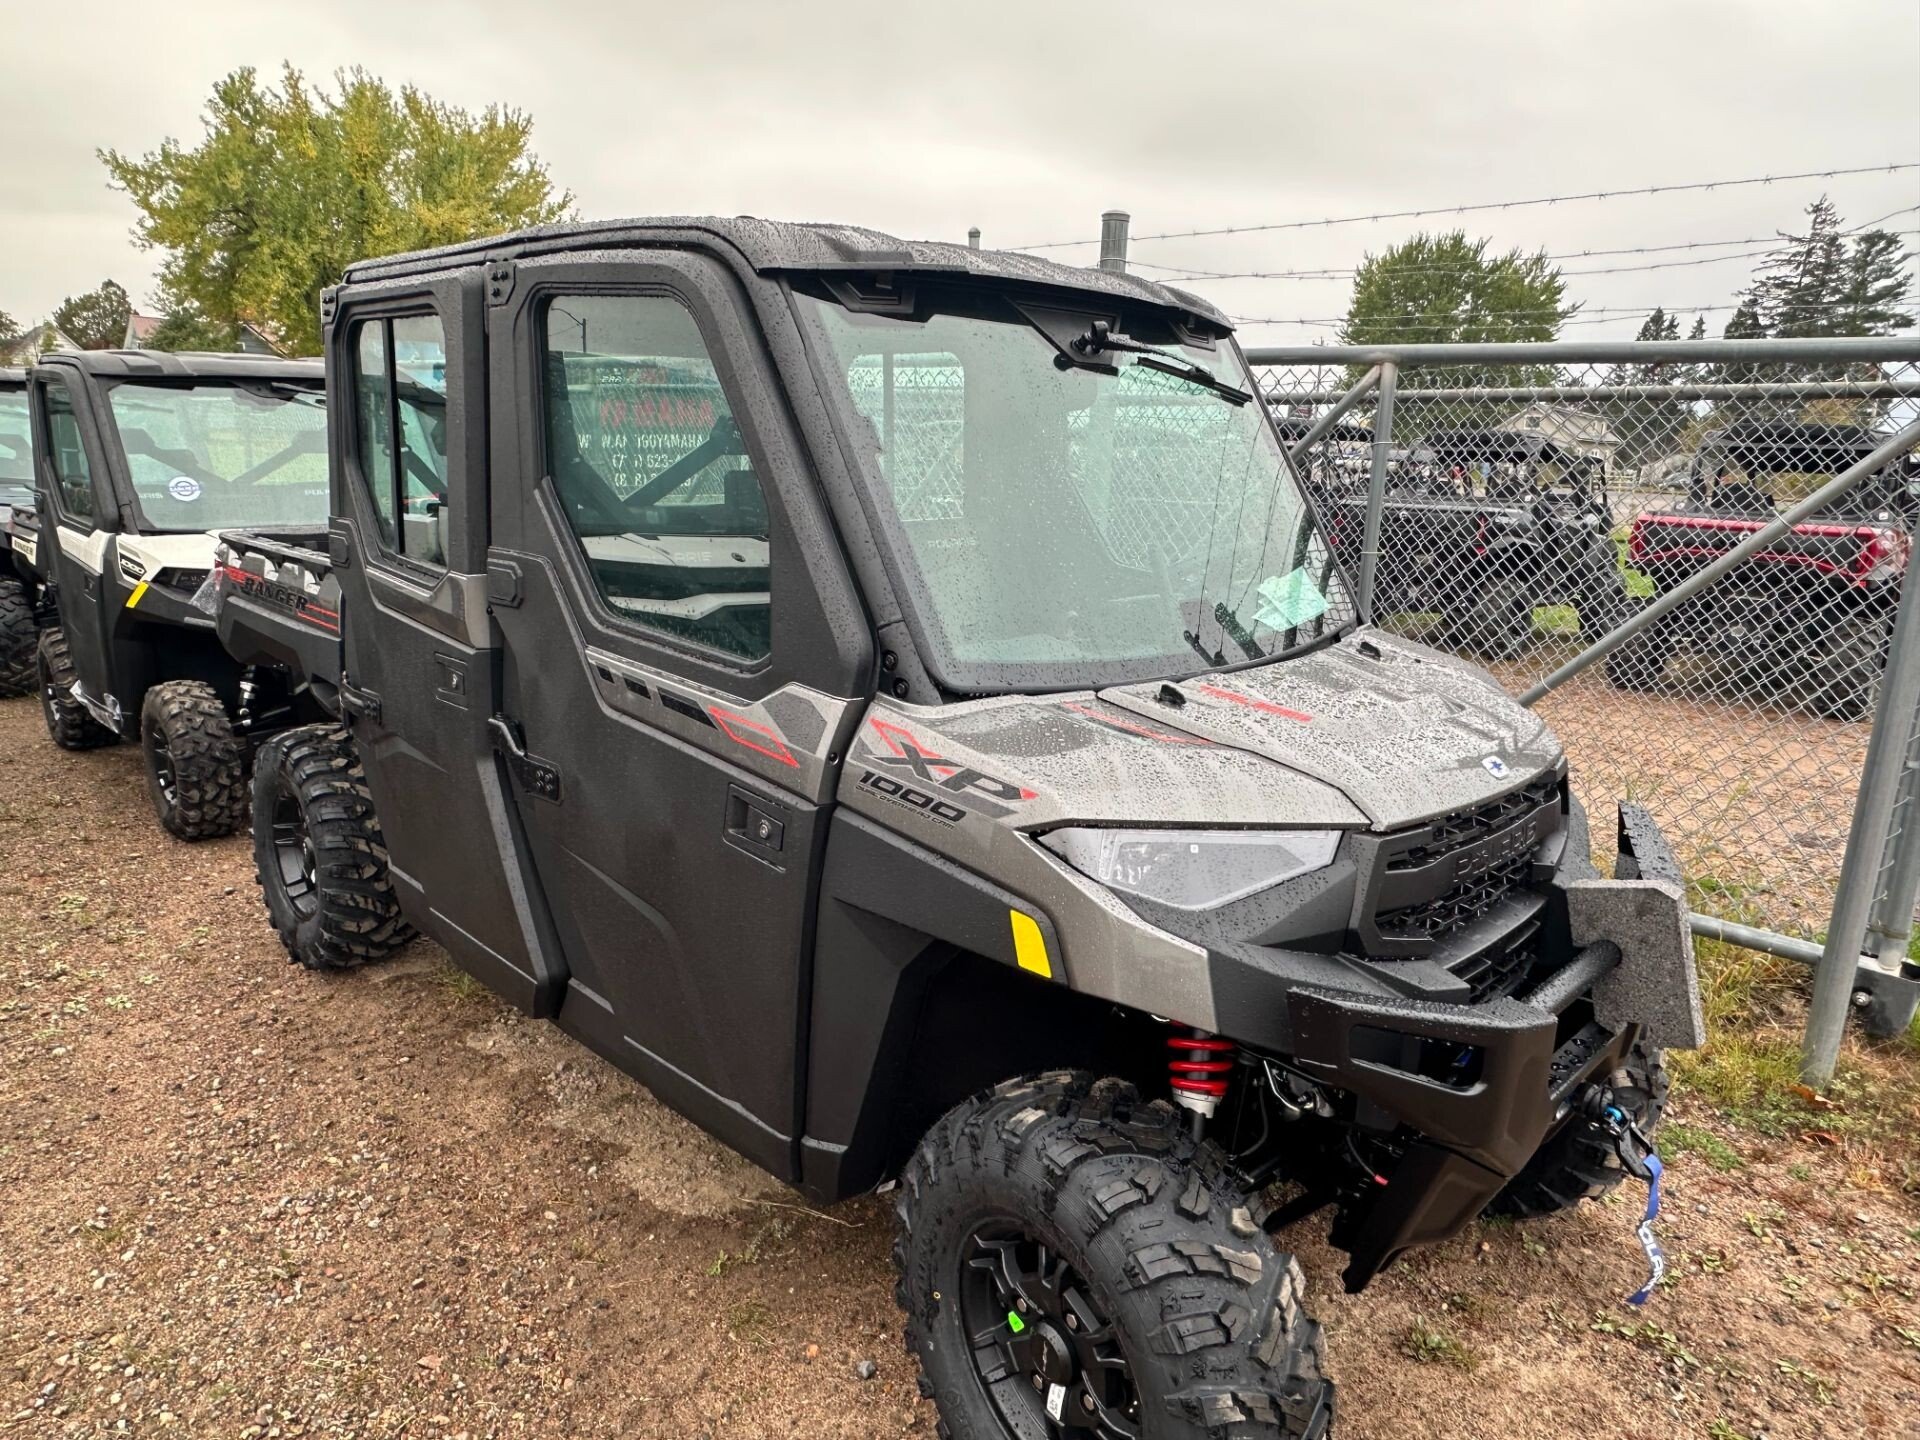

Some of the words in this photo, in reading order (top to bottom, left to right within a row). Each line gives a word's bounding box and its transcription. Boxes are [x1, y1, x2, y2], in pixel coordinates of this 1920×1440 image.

[243, 576, 310, 611] RANGER
[862, 731, 1031, 802] XP
[858, 770, 968, 822] 1000
